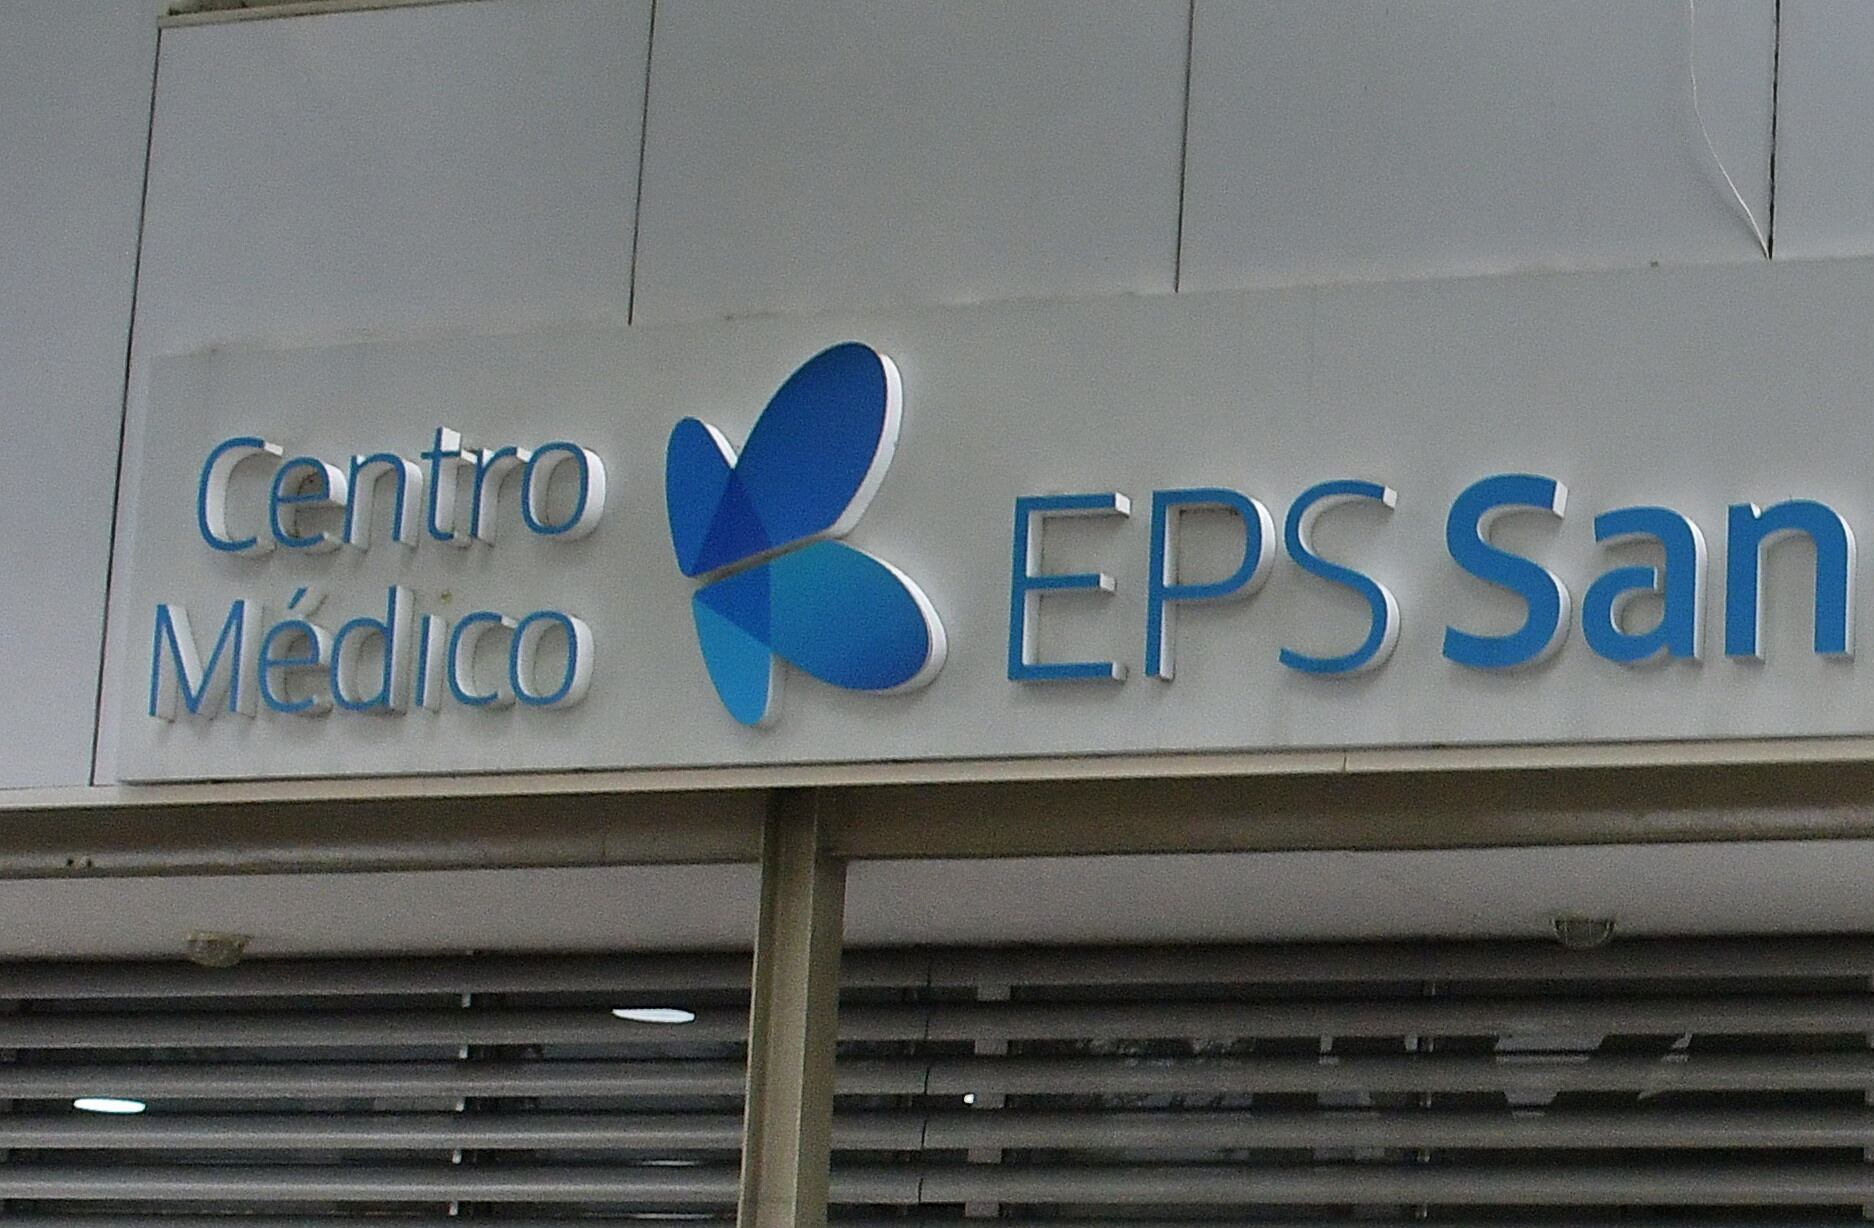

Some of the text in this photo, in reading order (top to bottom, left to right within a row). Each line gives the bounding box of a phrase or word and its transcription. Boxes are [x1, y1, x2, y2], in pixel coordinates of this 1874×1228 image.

[197, 428, 596, 554] Centro
[1007, 479, 1395, 682] EPS
[148, 586, 588, 717] Médico
